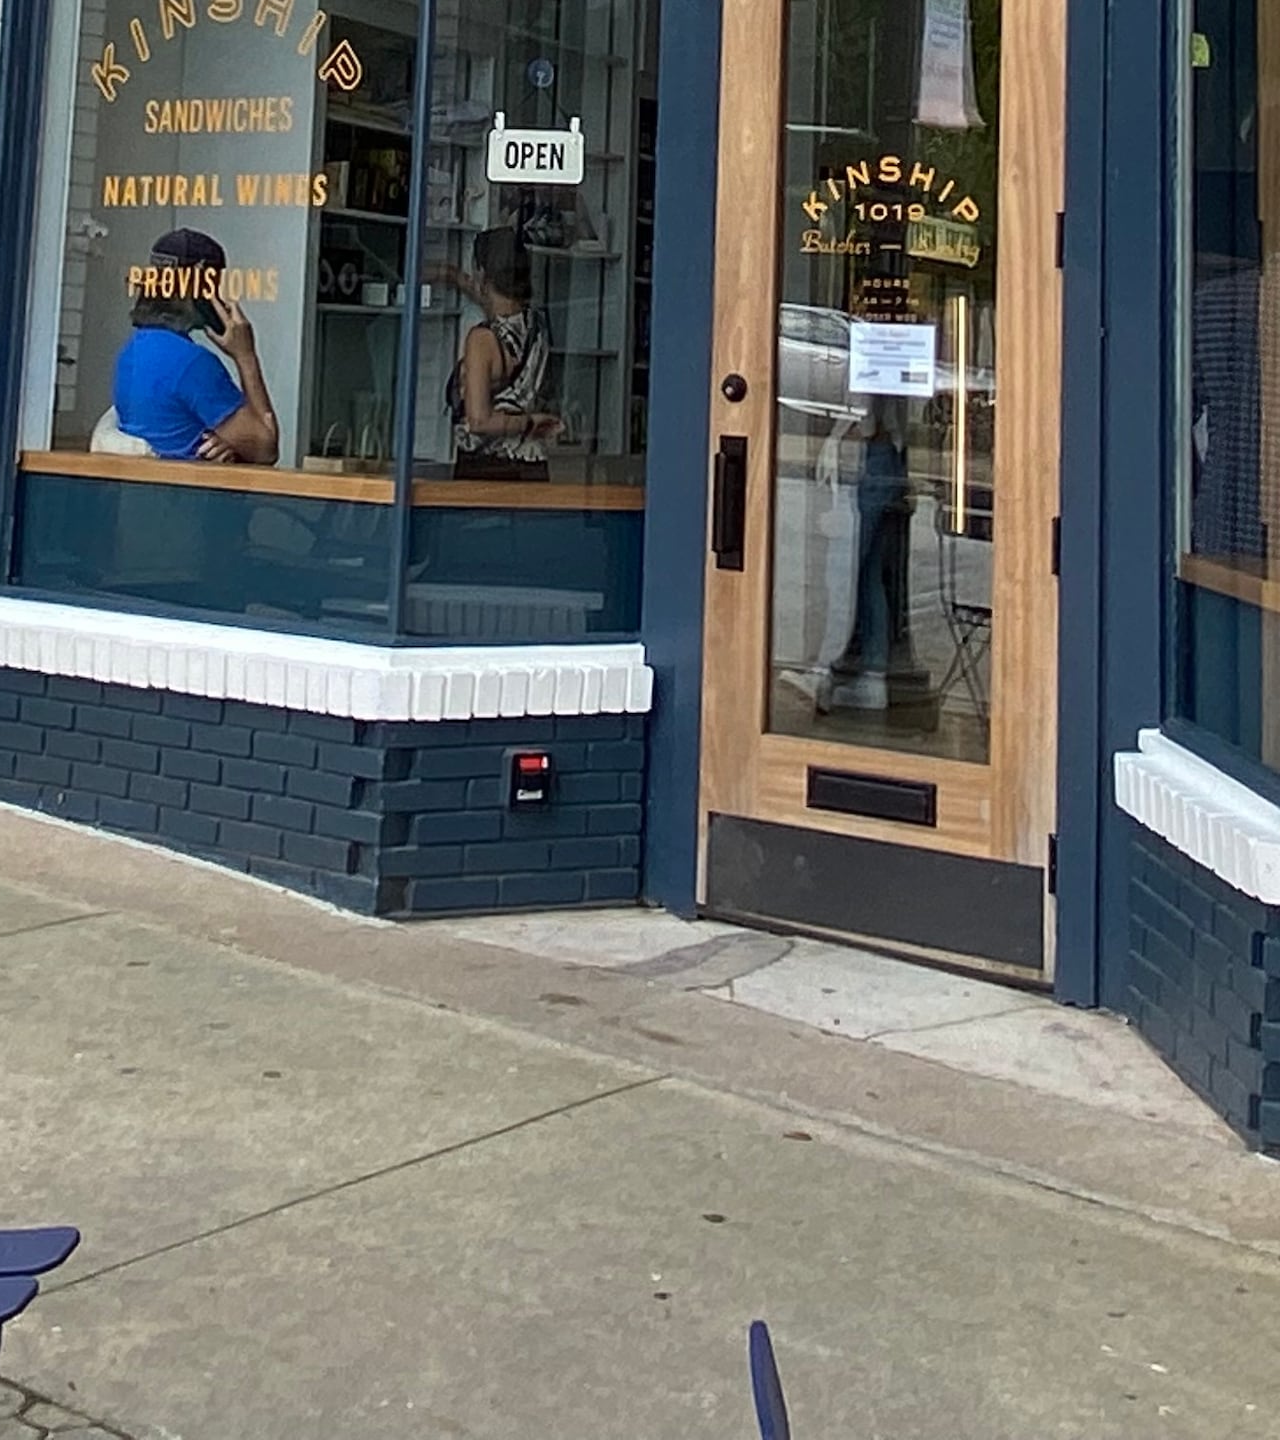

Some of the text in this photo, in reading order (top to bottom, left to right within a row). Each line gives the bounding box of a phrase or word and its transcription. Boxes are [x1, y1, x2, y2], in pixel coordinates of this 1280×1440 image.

[144, 97, 295, 135] SANDWICHES
[504, 141, 565, 171] OPEN
[103, 174, 328, 208] NATURAL WINES
[802, 156, 980, 222] KINSHIP
[854, 203, 926, 222] 1019
[799, 229, 871, 256] Butcher
[128, 266, 279, 303] PROVISIONS
